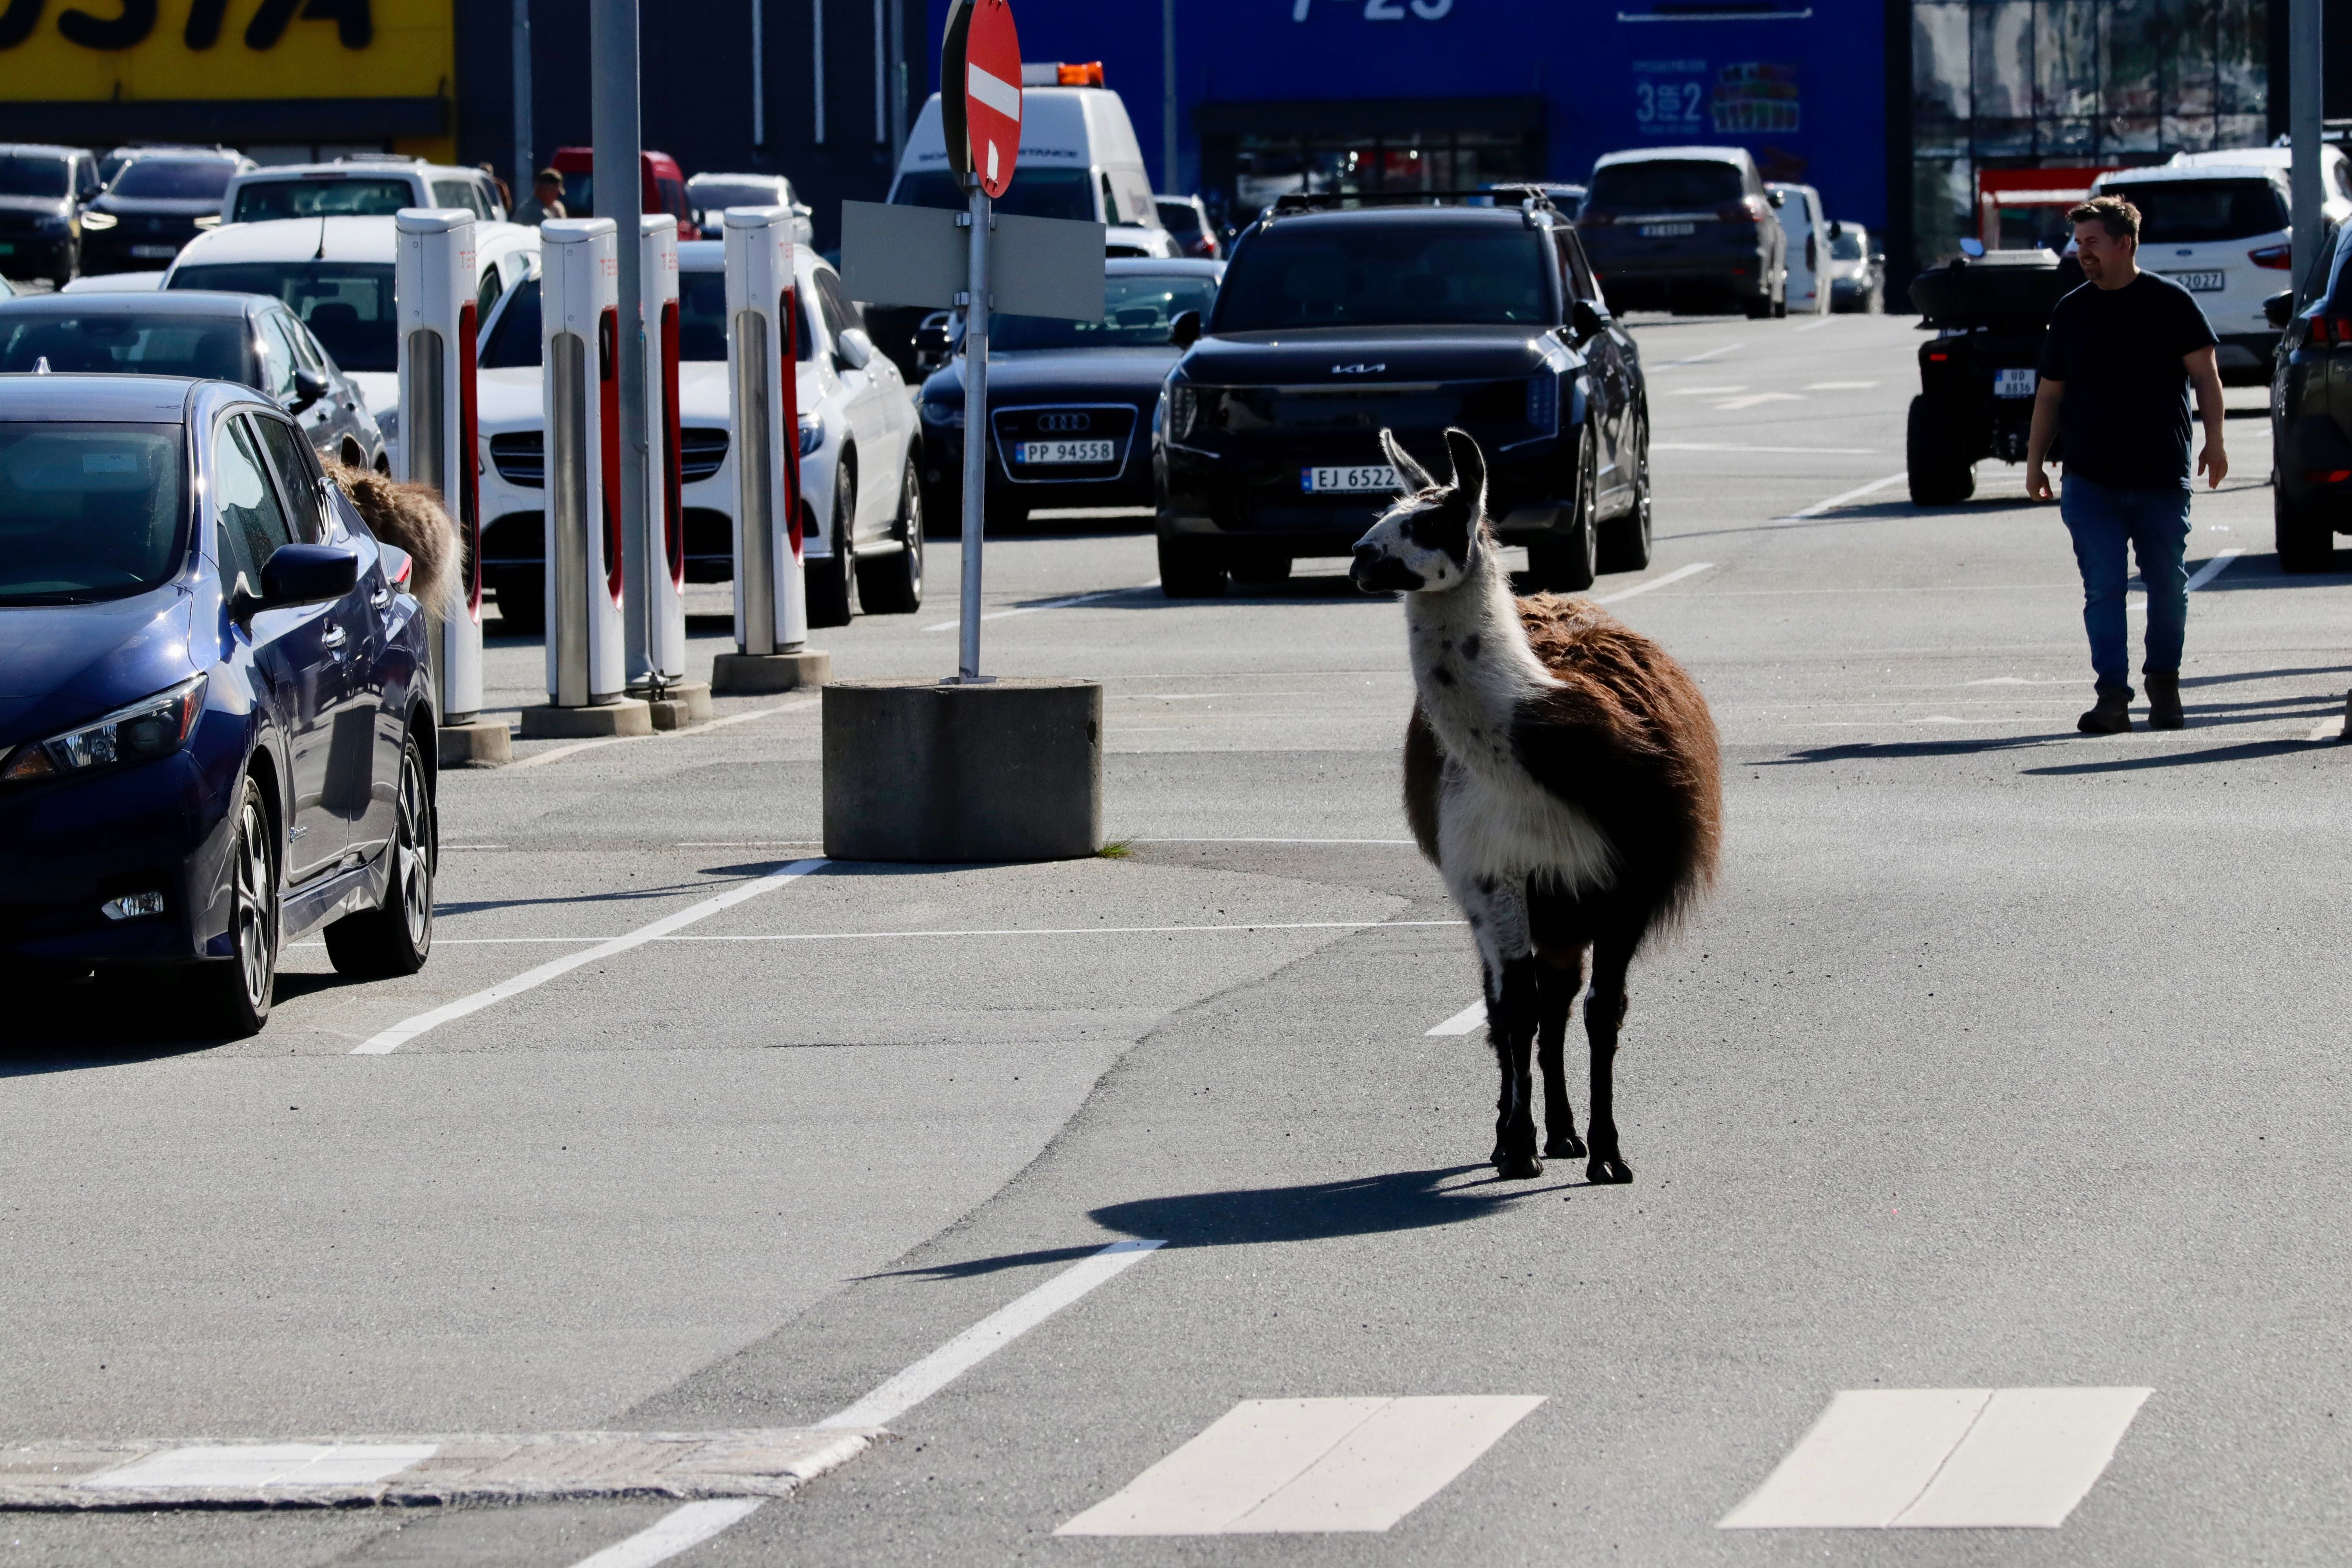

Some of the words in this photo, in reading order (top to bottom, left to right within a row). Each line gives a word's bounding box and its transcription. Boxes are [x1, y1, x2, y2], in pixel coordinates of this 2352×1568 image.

[1636, 82, 1653, 122] 3
[1684, 82, 1701, 121] 2
[1029, 445, 1049, 460] PP
[1058, 443, 1109, 459] 94558
[1319, 470, 1338, 487] EJ
